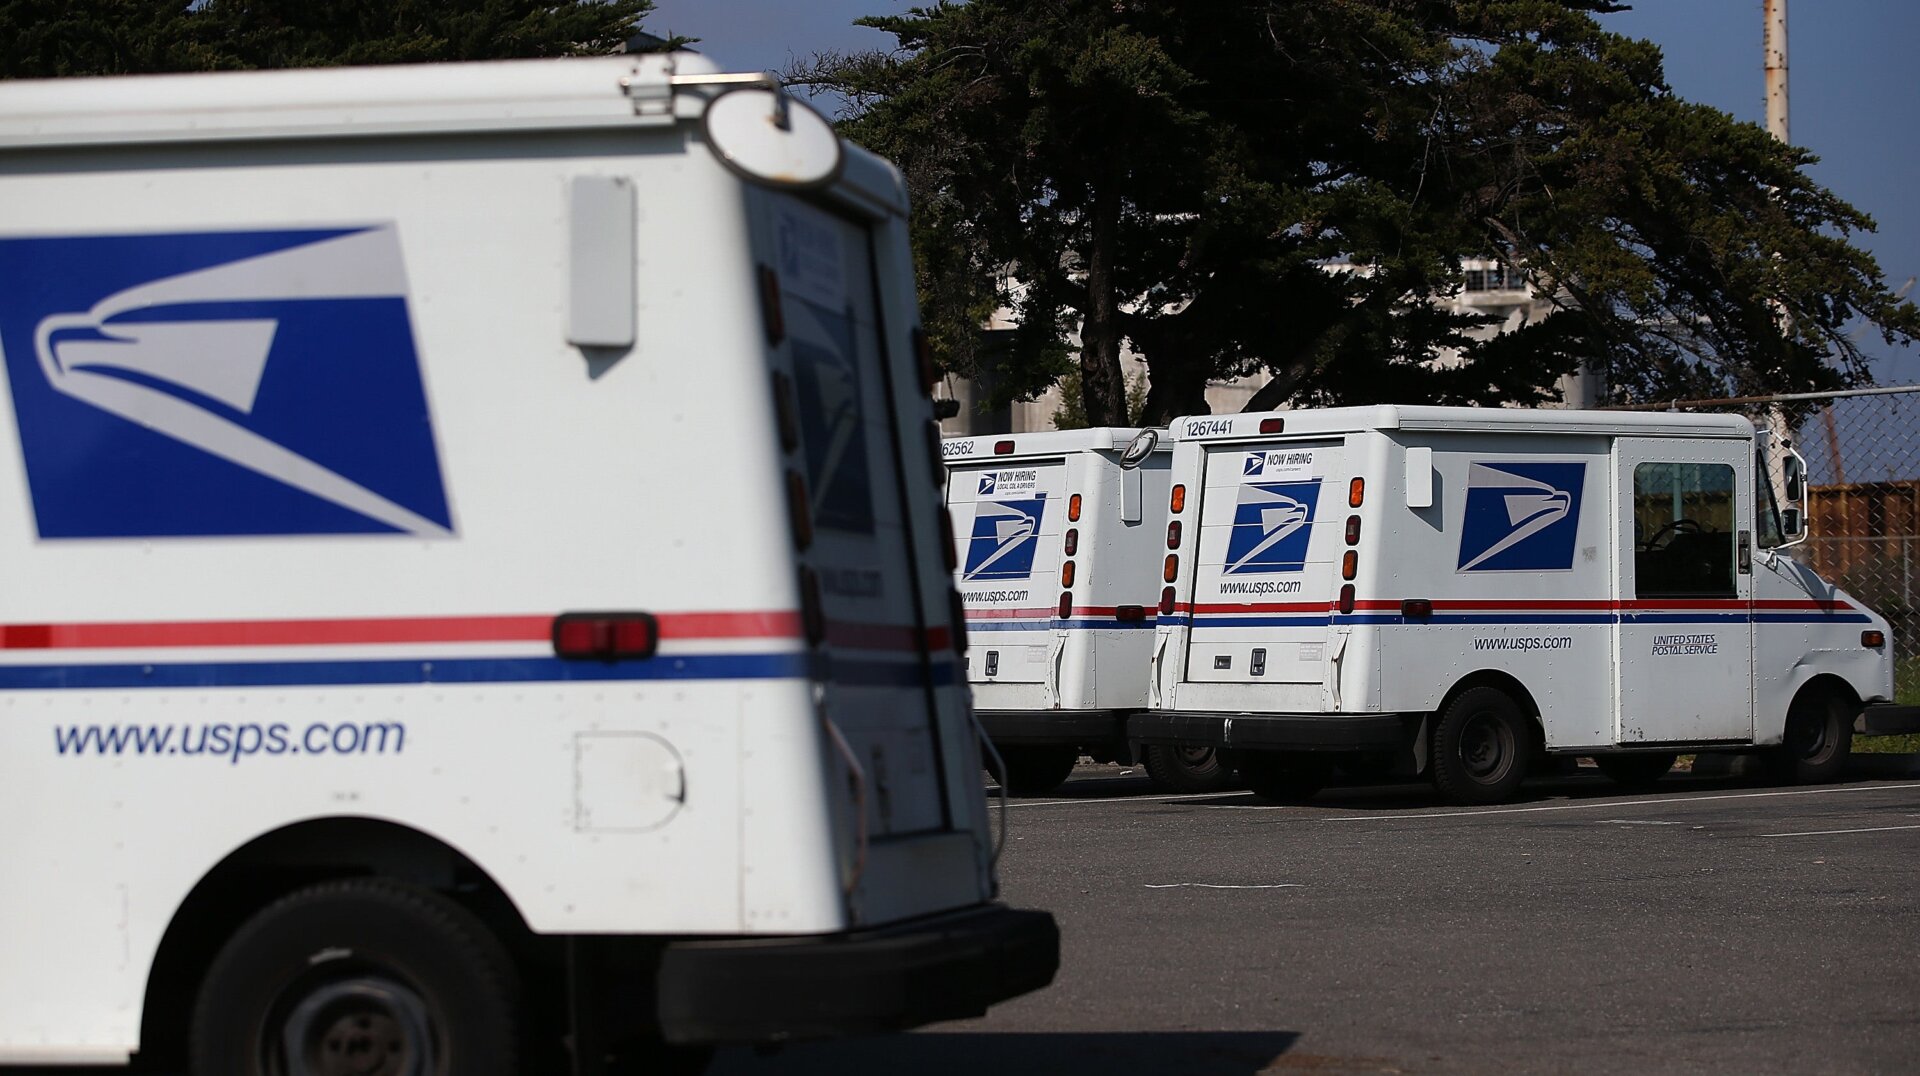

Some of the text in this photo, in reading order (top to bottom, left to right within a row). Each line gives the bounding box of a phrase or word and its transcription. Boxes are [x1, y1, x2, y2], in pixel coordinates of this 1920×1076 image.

[1187, 420, 1233, 437] 1267441
[939, 441, 974, 456] 62562
[1267, 452, 1313, 466] NOW HIRING
[998, 470, 1036, 483] NOW HIRING
[1220, 580, 1301, 597] www.usps.com
[960, 590, 1029, 605] www.usps.com
[1474, 636, 1572, 652] www.usps.com
[1653, 634, 1716, 645] UNITED STATES
[1651, 644, 1718, 656] POSTAL SERVICE
[54, 721, 405, 766] www.usps.com
